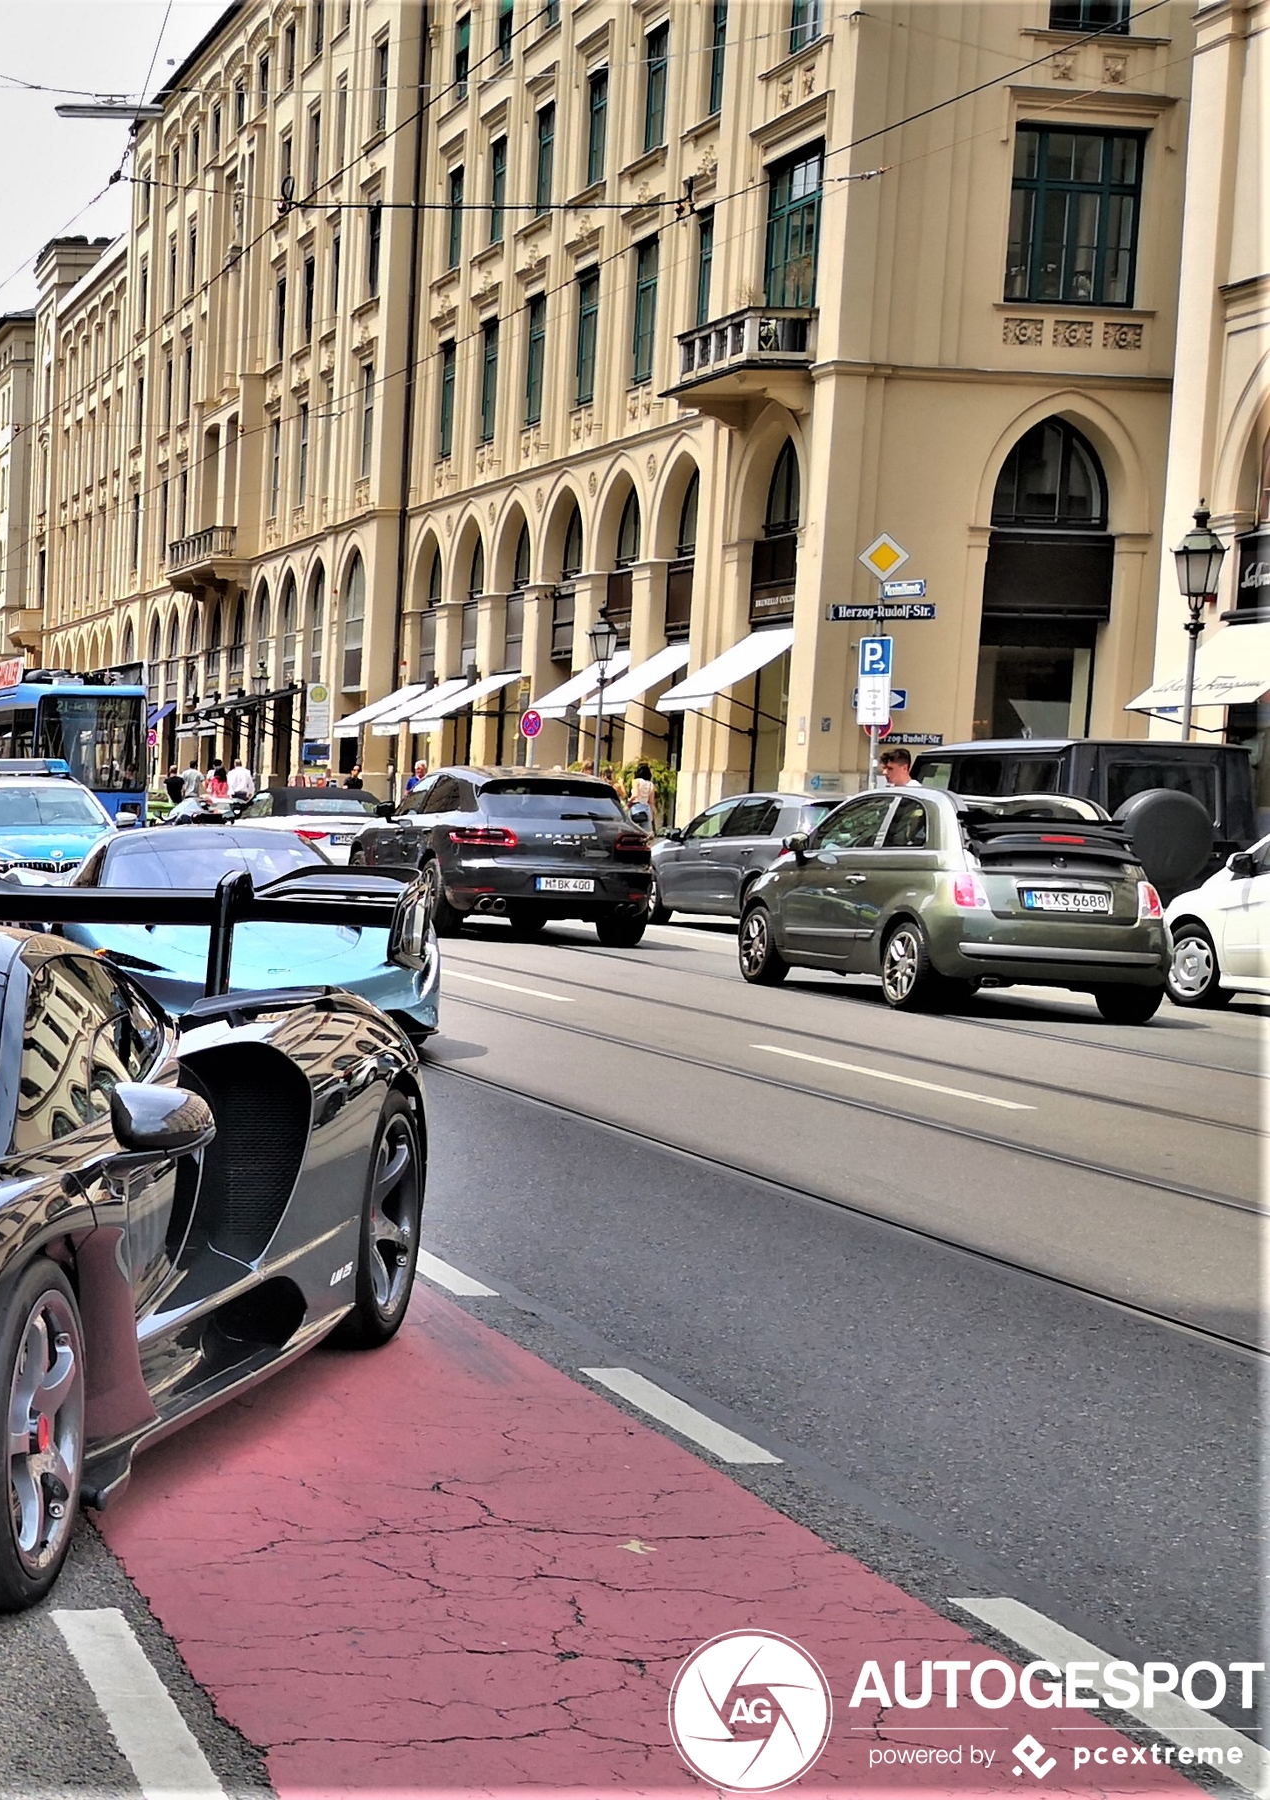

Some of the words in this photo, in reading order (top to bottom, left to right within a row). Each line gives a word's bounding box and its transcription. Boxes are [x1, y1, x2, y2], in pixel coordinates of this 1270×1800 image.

[838, 604, 932, 620] Herzog-Rudolf-Str.
[864, 642, 883, 672] P
[1033, 892, 1044, 905] M
[1052, 893, 1070, 906] XS
[1072, 894, 1106, 909] 6688
